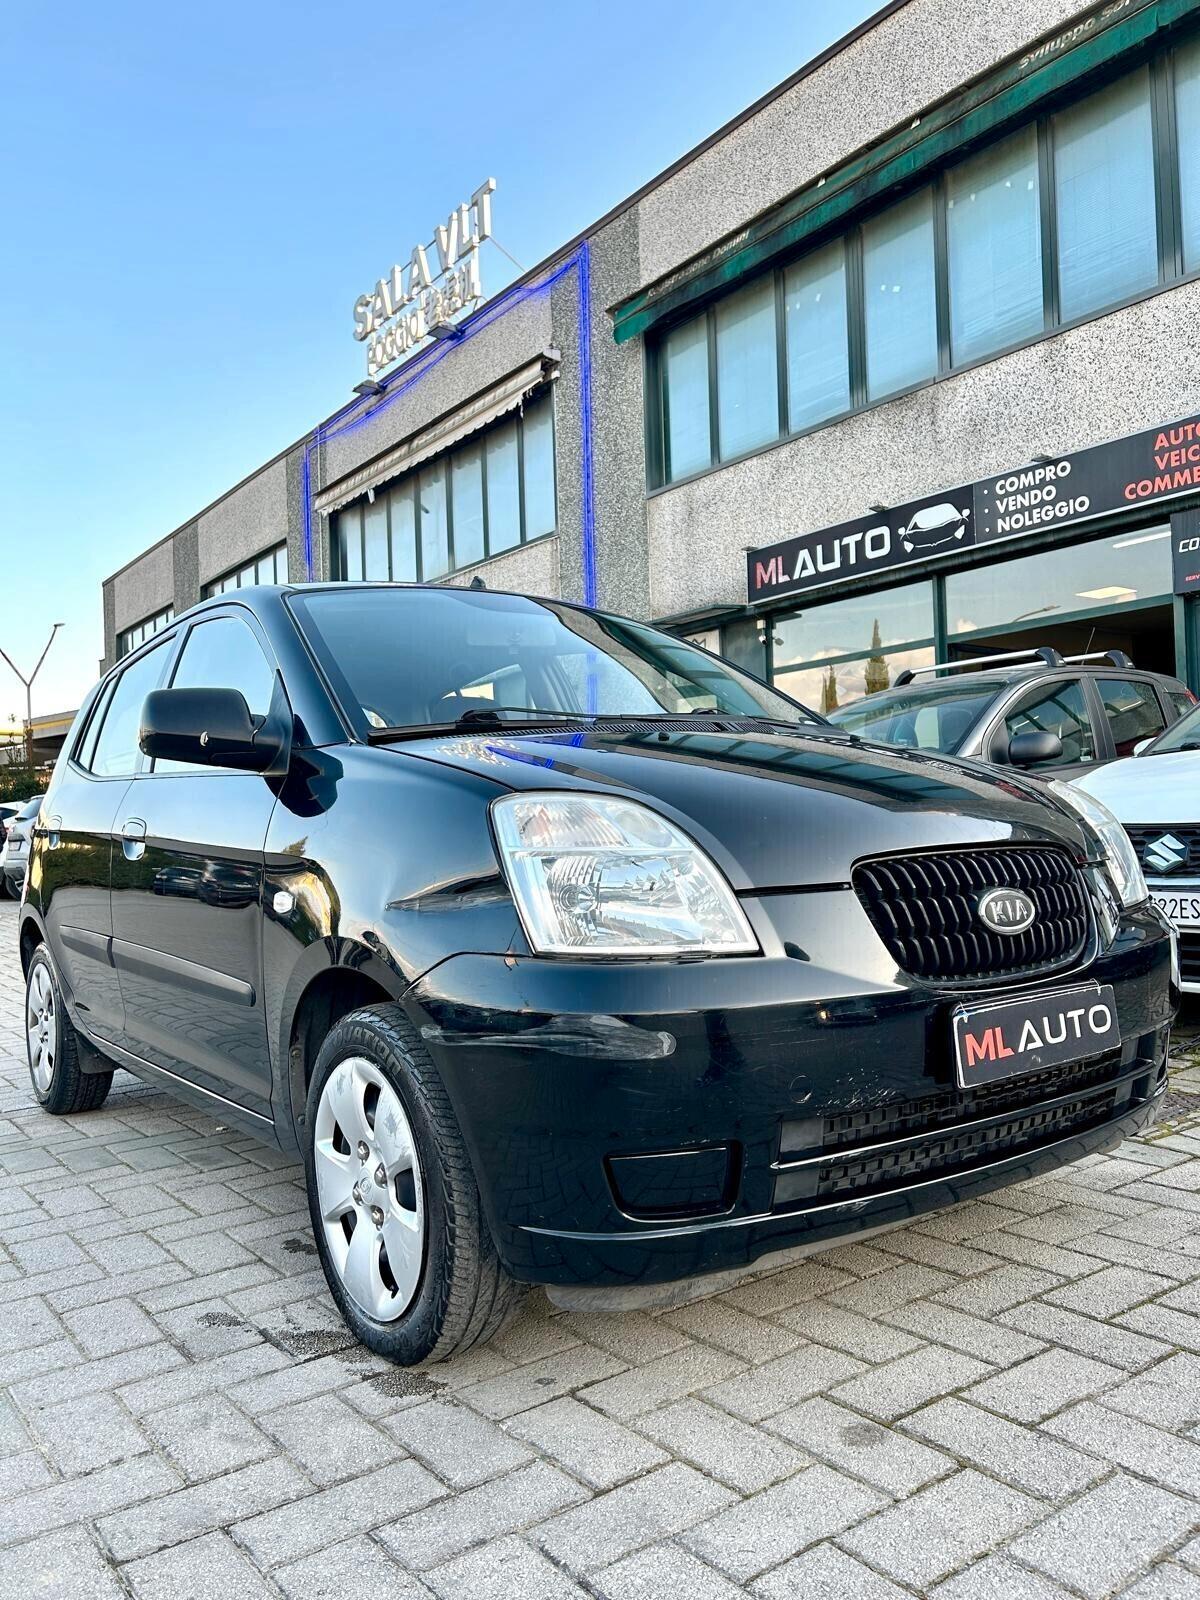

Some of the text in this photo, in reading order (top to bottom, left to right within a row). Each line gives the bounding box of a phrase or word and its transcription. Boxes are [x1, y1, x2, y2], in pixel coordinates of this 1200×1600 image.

[353, 177, 497, 342] SALA VLT
[1154, 444, 1200, 471] VEIC
[995, 460, 1072, 496] COMPRO
[1124, 468, 1200, 500] COMME
[996, 485, 1057, 514] VENDO
[997, 495, 1090, 533] NOLEGGIO
[989, 899, 1028, 923] KIA
